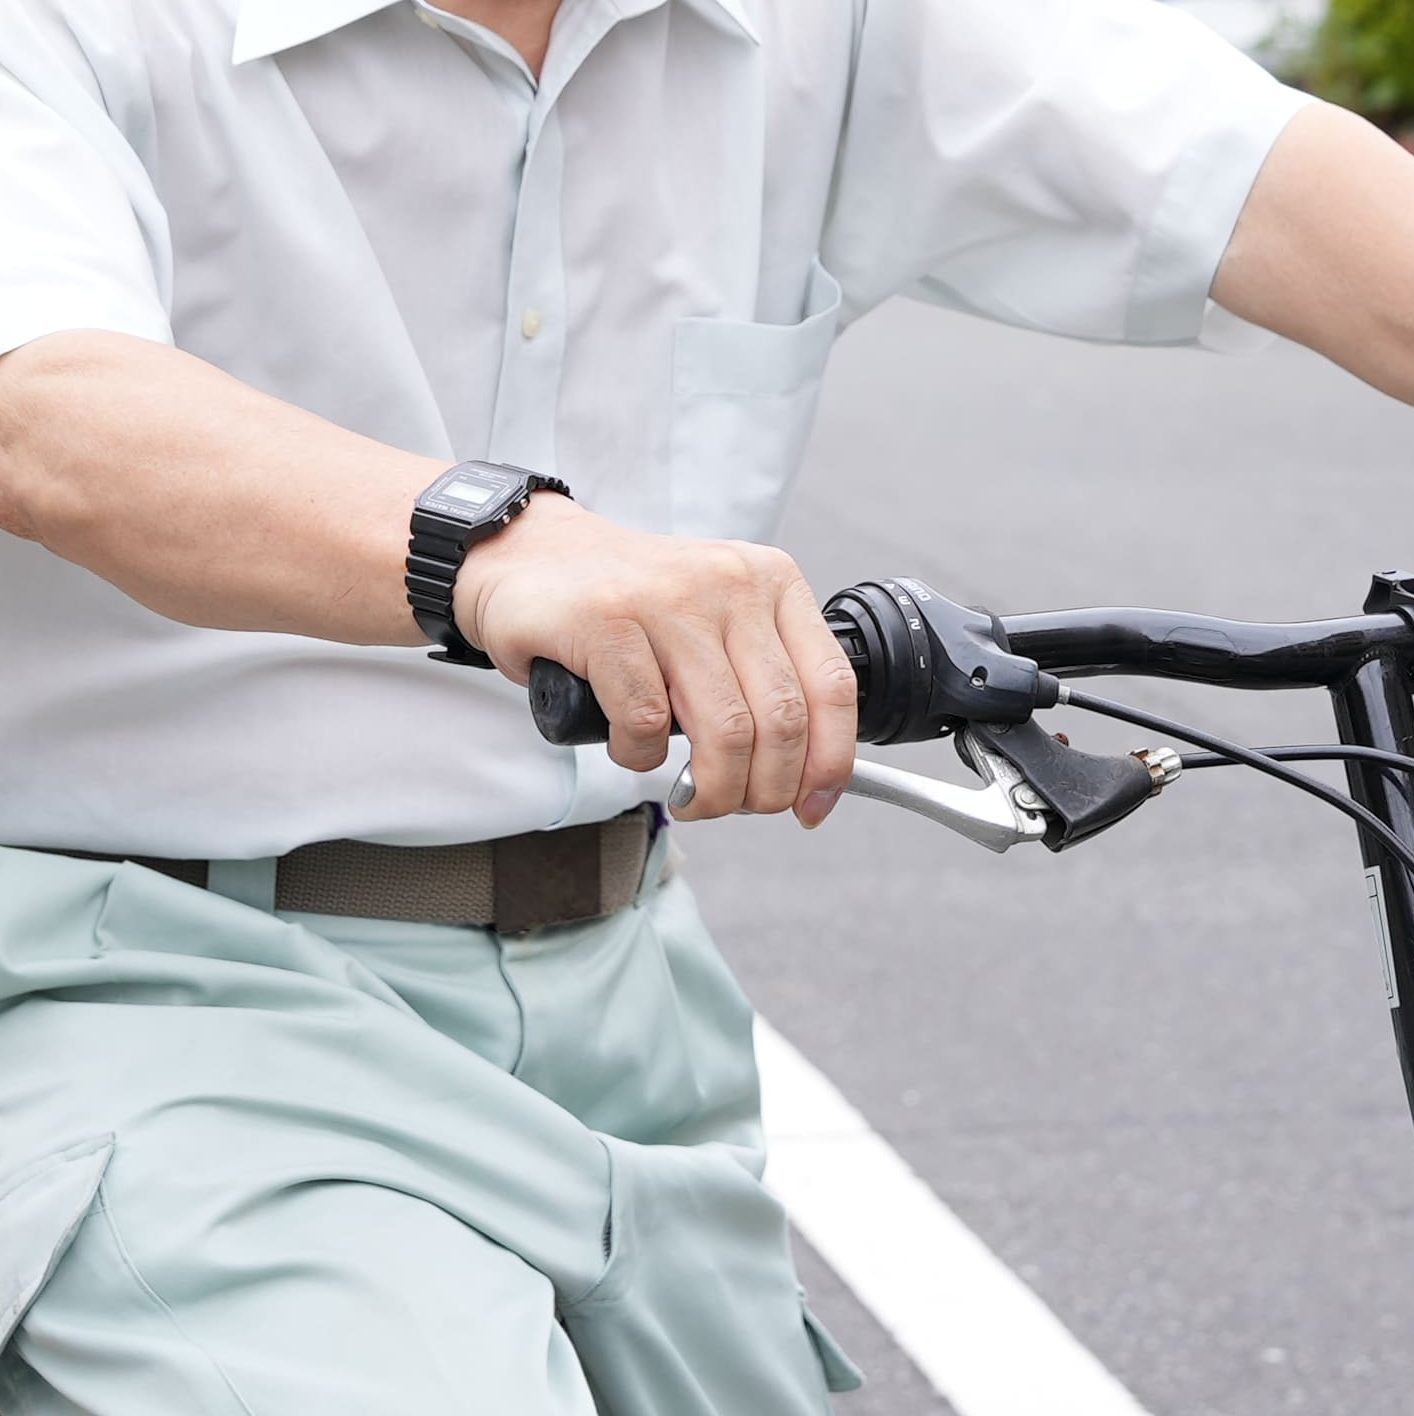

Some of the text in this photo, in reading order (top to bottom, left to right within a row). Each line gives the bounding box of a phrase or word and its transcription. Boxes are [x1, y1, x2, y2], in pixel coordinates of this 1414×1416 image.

[898, 595, 910, 605] 3
[909, 618, 921, 630] 2
[919, 655, 926, 669] 1
